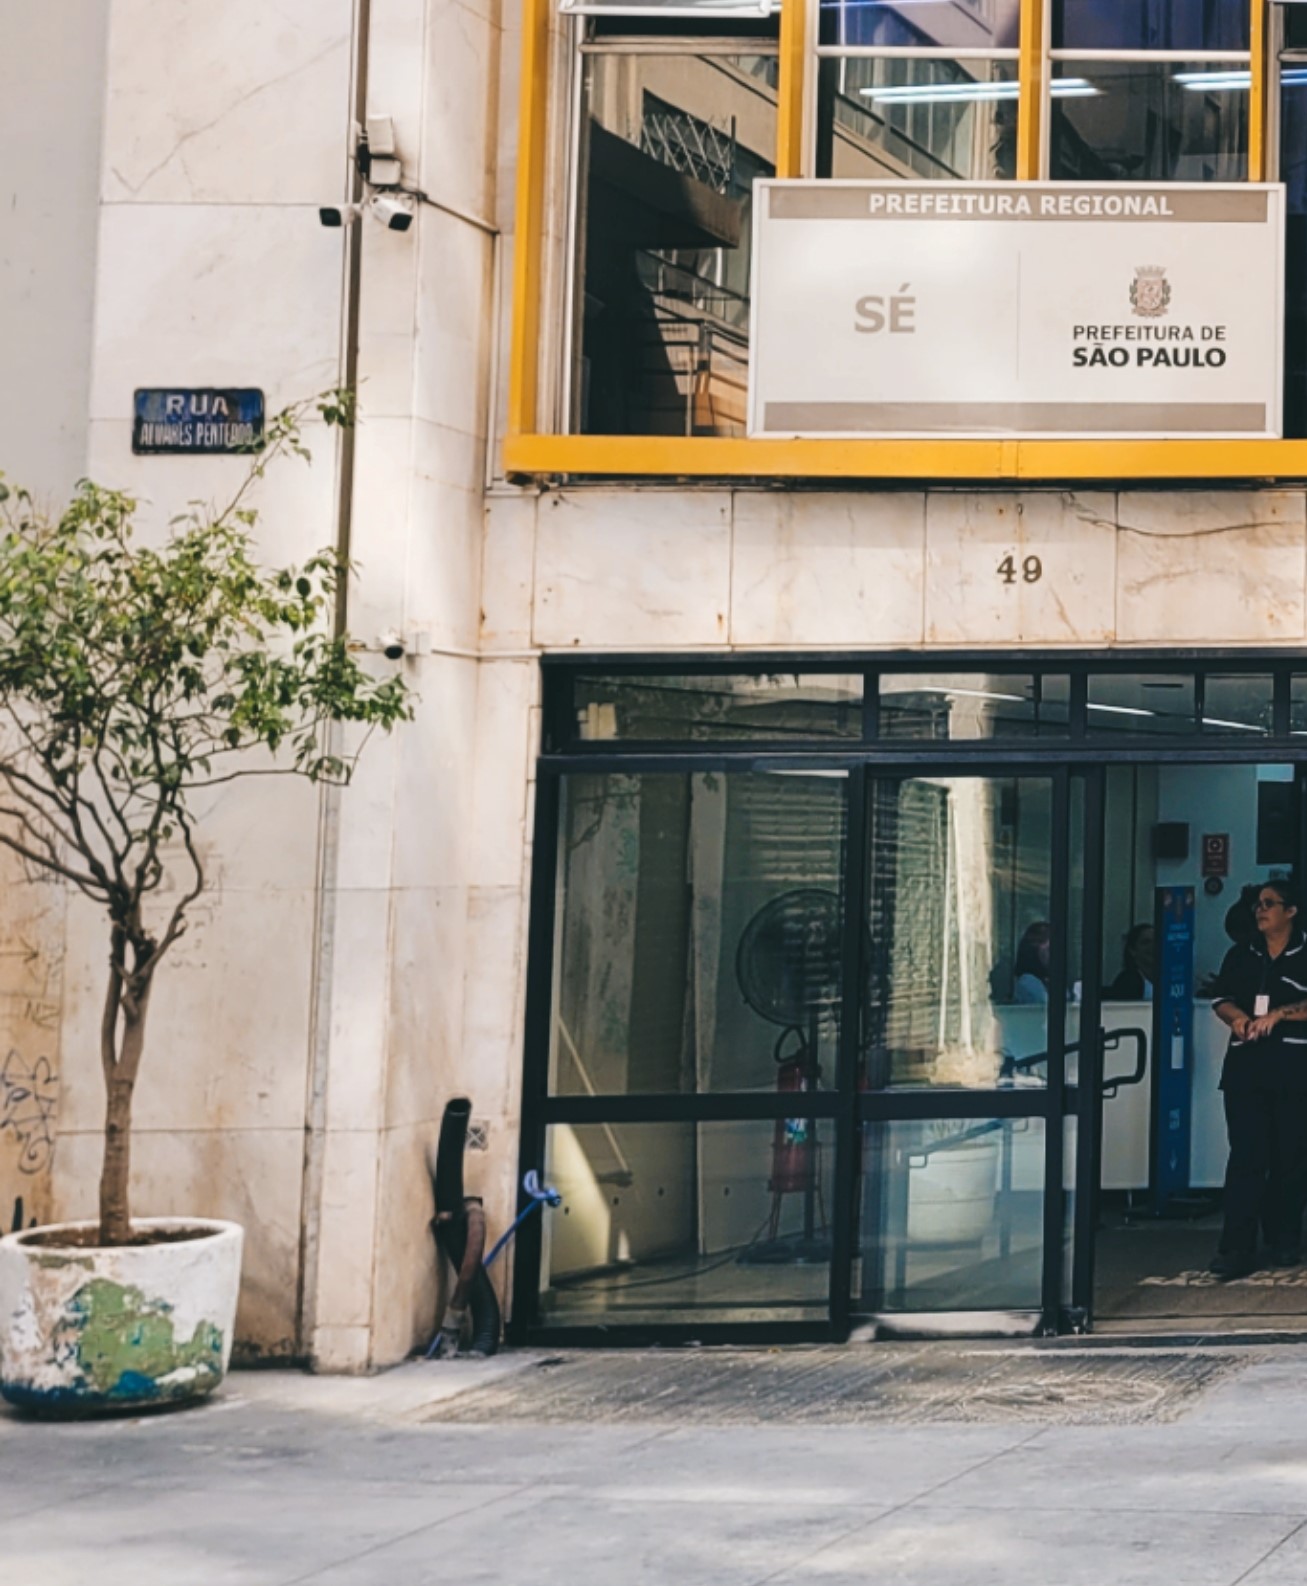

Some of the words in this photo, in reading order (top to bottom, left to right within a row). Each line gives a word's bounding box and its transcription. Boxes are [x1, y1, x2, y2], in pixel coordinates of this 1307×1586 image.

[869, 193, 1032, 215] PREFEITURA
[1040, 195, 1174, 216] REGIONAL
[854, 282, 917, 334] SÉ
[1073, 325, 1194, 341] PREFEITURA
[1200, 325, 1227, 341] DE
[1072, 342, 1130, 368] SÃO
[1136, 347, 1227, 368] PAULO
[165, 394, 230, 416] RUA
[996, 554, 1043, 585] 49
